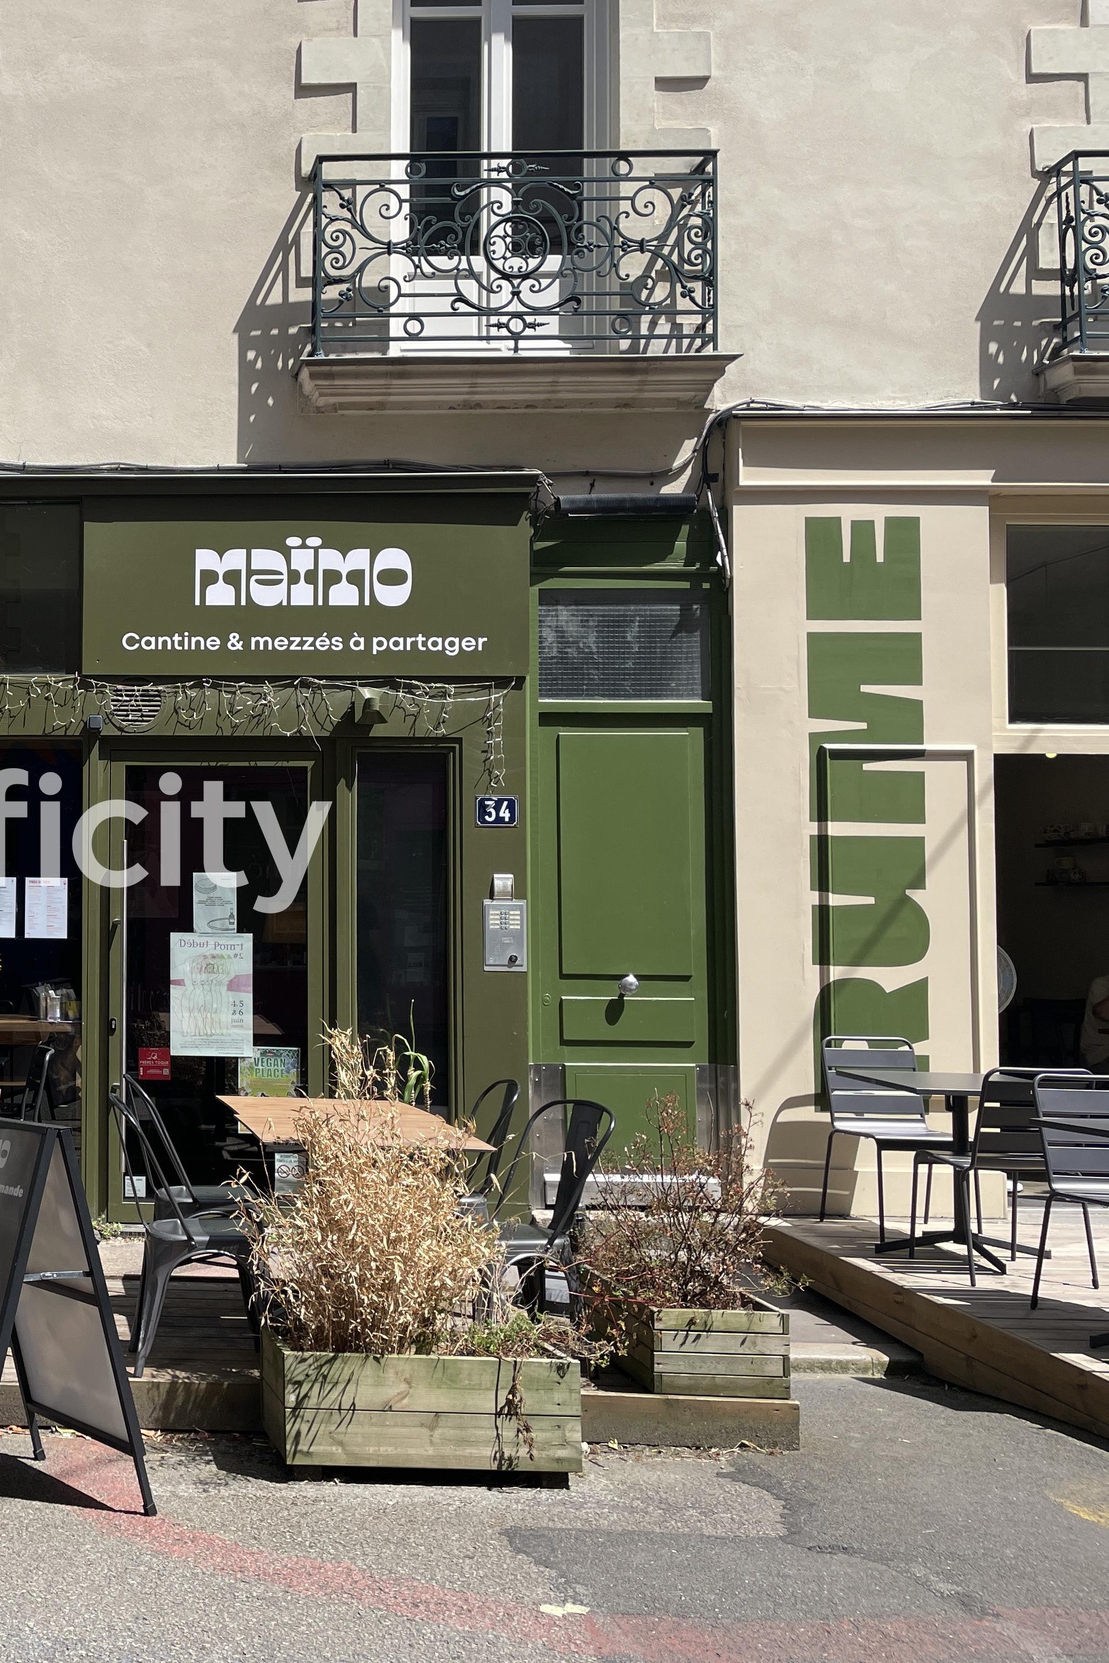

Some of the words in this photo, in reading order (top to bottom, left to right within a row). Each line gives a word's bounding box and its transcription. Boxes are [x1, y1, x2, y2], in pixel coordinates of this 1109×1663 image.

[121, 632, 221, 652] Cantine
[227, 632, 244, 652] &
[250, 632, 344, 652] mezzés
[350, 631, 365, 652] à
[372, 634, 489, 656] partager
[484, 800, 511, 822] 34
[253, 1057, 286, 1068] VEGAN
[254, 1067, 285, 1079] PLACE
